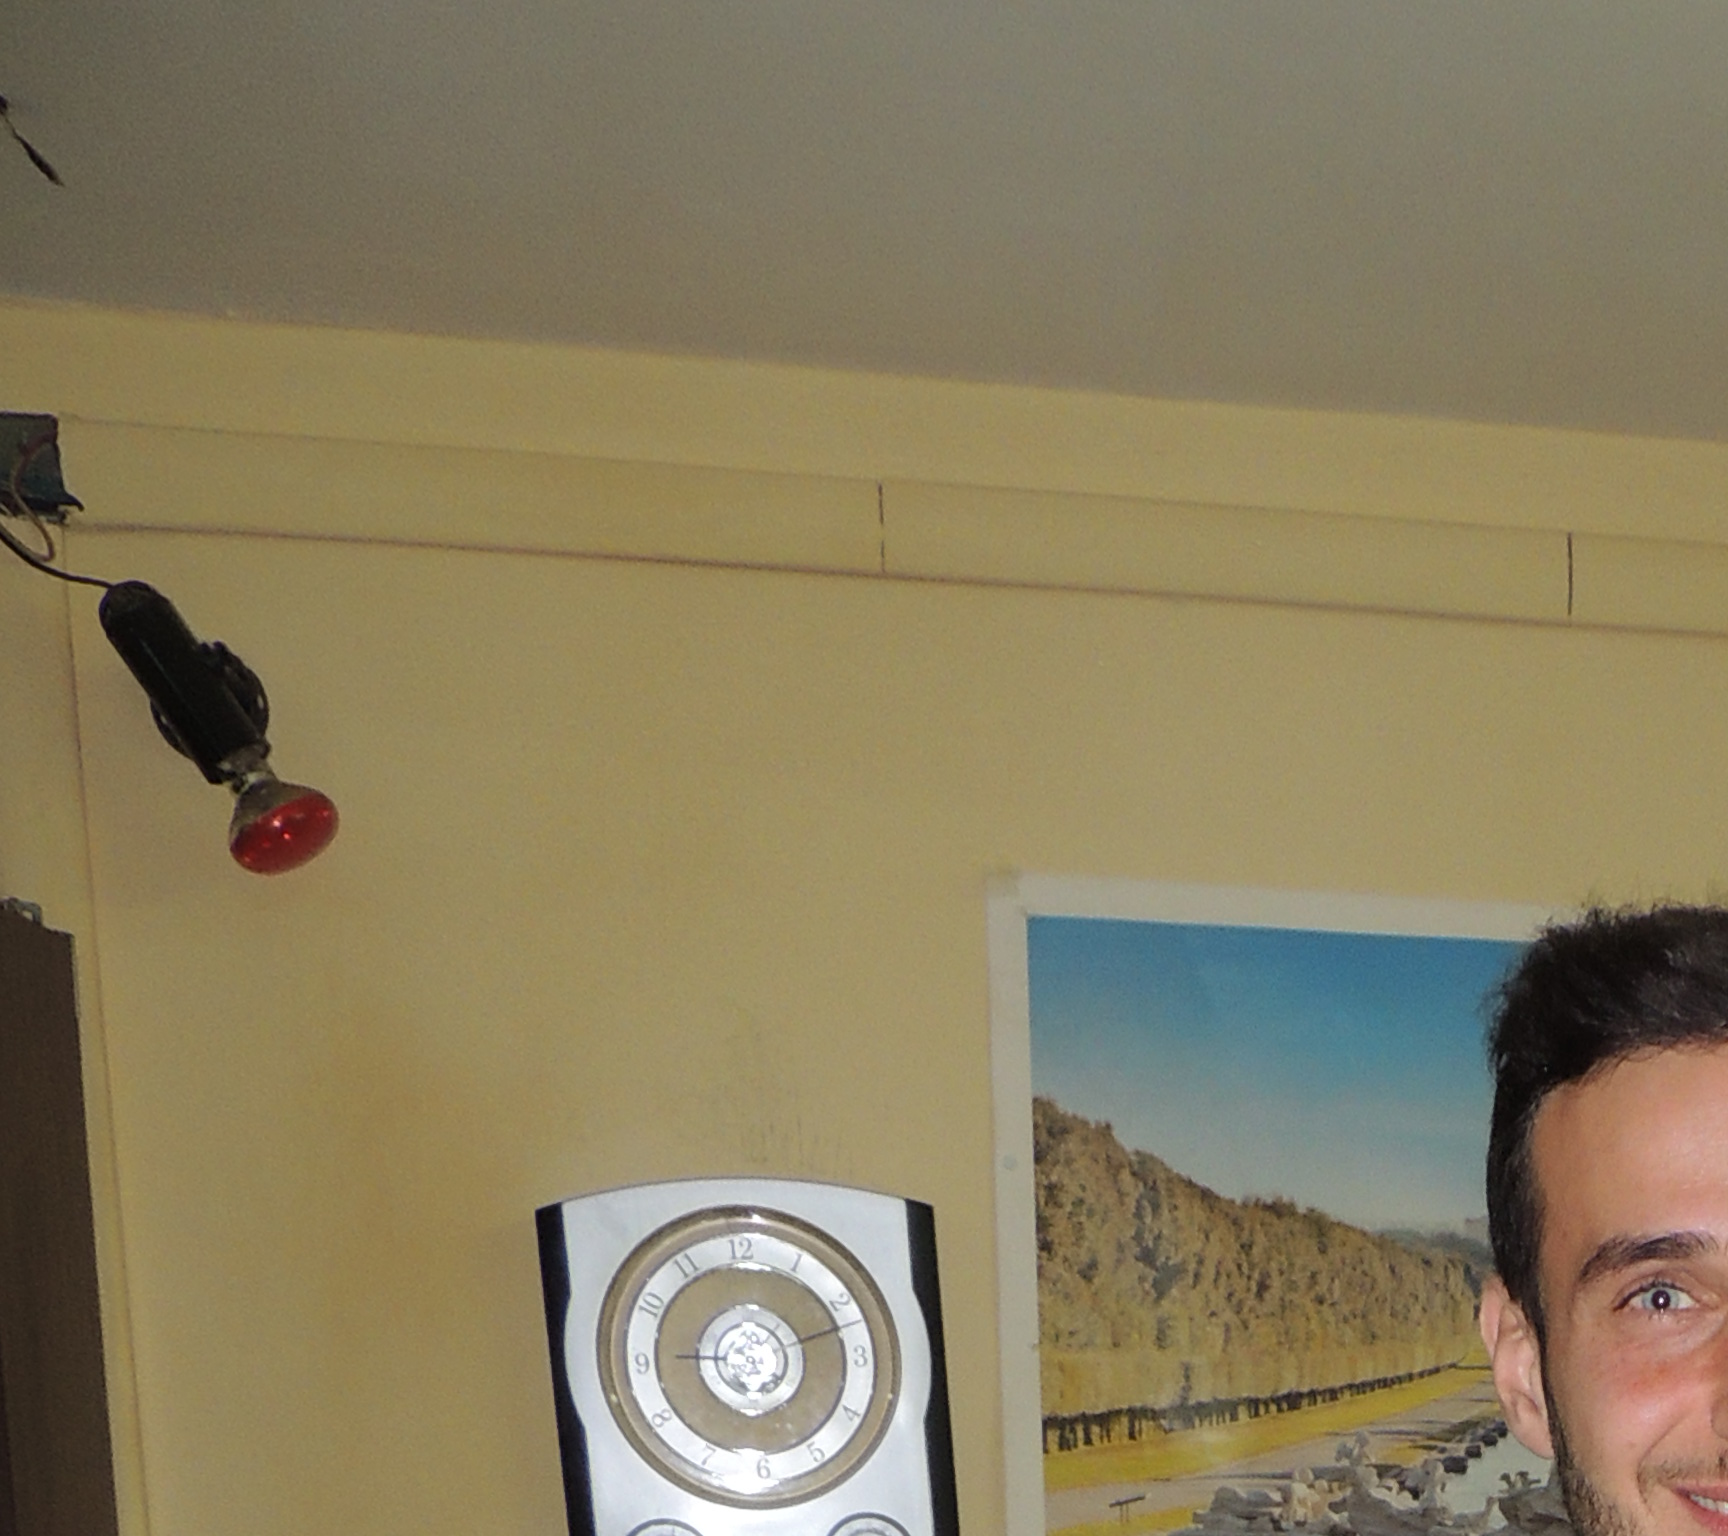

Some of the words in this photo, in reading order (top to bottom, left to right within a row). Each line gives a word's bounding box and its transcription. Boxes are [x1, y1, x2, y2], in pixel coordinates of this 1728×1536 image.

[727, 1237, 754, 1260] 12
[672, 1253, 699, 1279] 11
[790, 1252, 804, 1273] 1
[638, 1291, 664, 1318] 10
[829, 1292, 851, 1312] 2
[634, 1352, 650, 1375] 9
[853, 1345, 868, 1367] 3
[651, 1408, 672, 1428] 8
[841, 1403, 861, 1422] 4
[700, 1443, 717, 1466] 7
[806, 1441, 825, 1463] 5
[756, 1458, 771, 1479] 6
